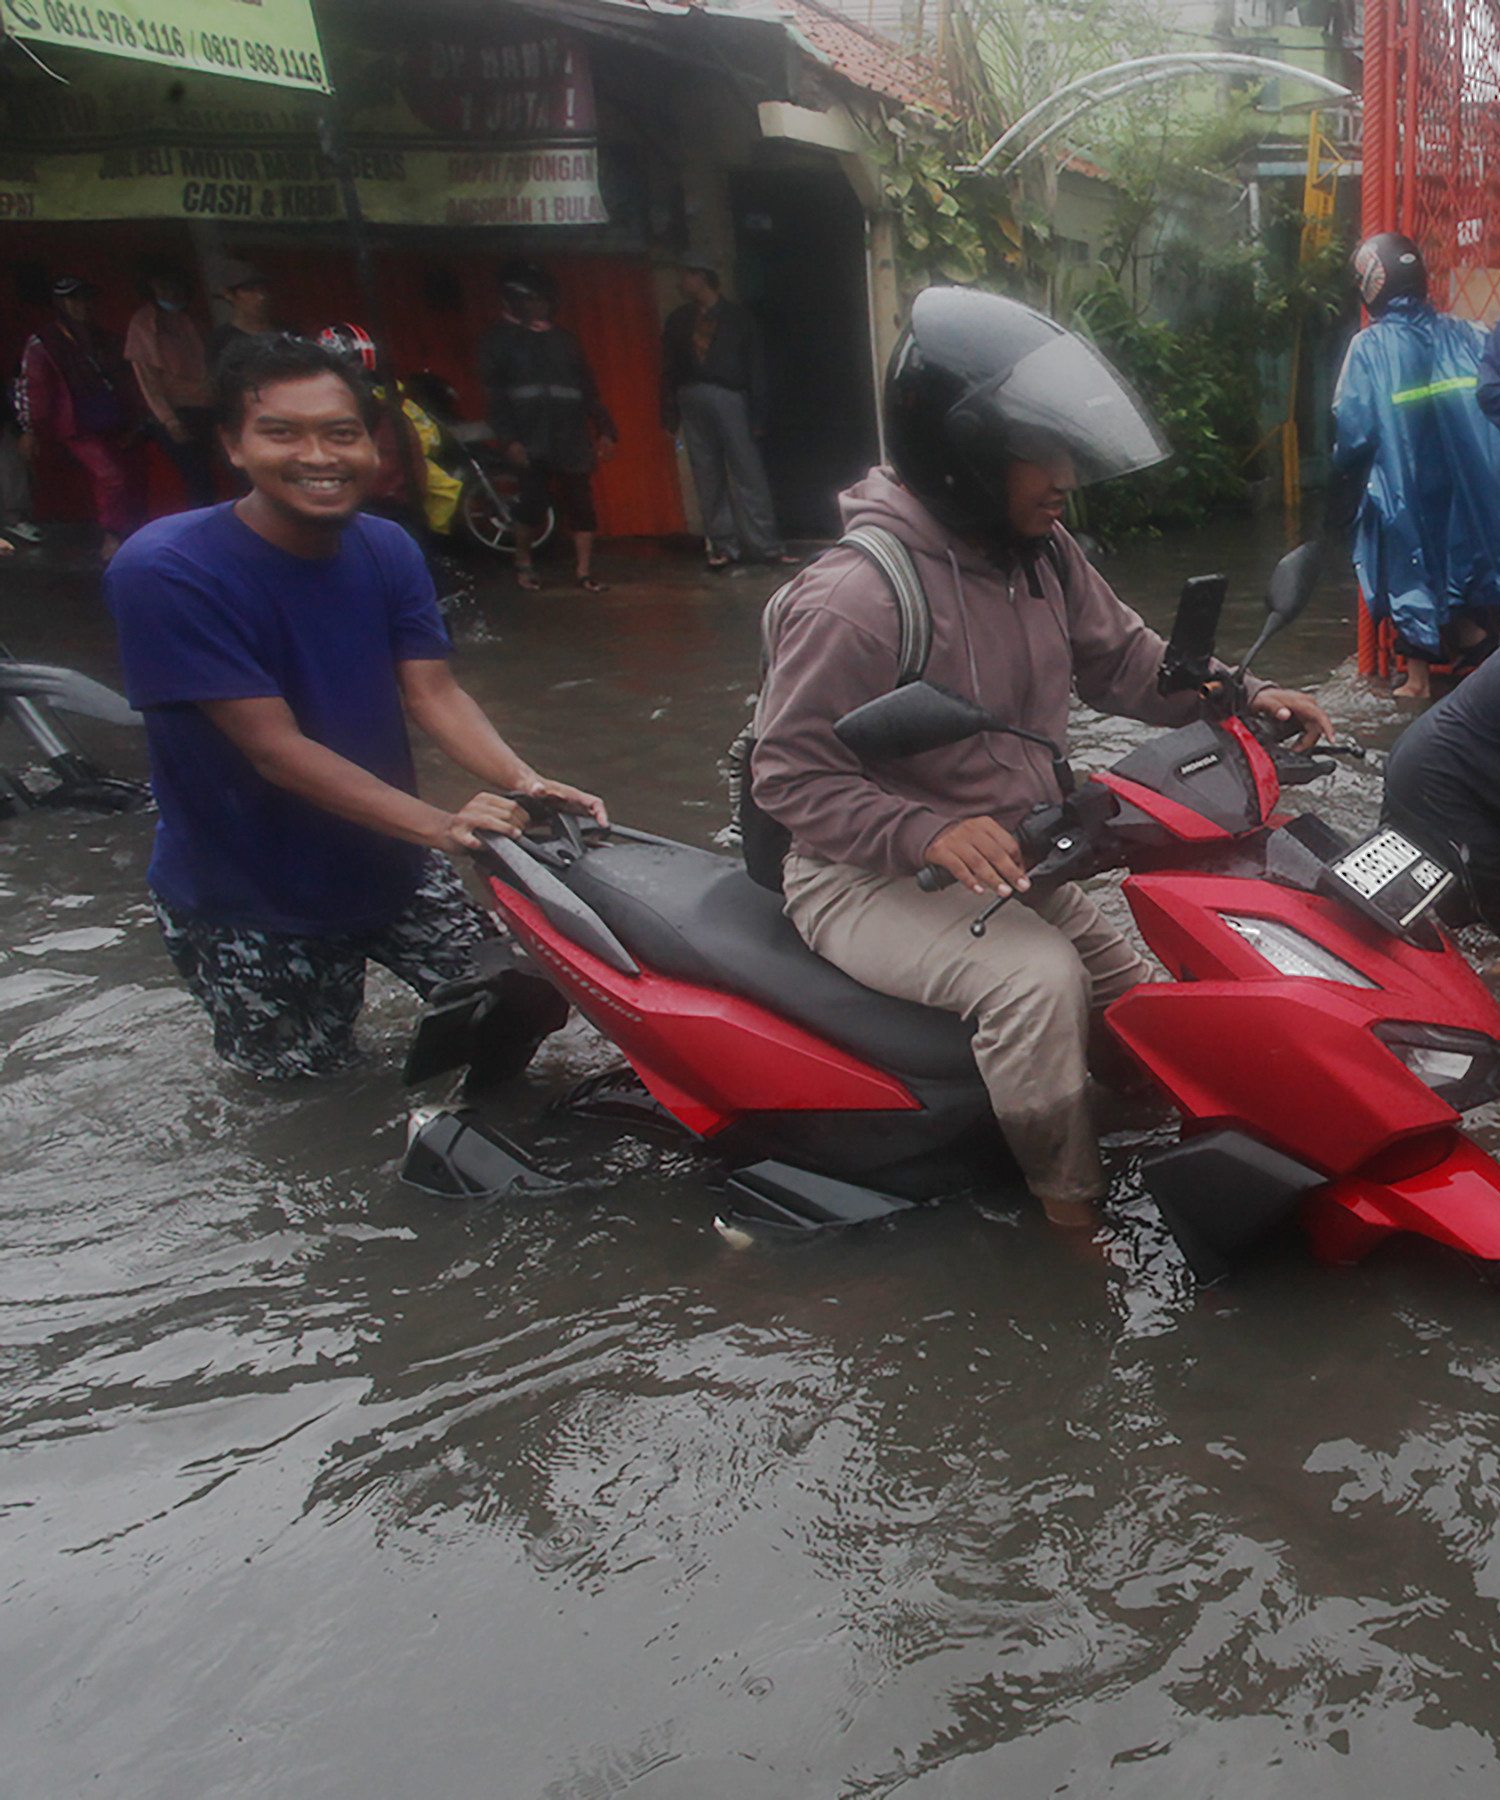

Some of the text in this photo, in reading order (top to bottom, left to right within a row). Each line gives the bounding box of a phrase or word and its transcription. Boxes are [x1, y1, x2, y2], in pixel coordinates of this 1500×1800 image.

[44, 1, 99, 41] 0811
[98, 9, 138, 48] 978
[137, 19, 187, 58] 1116
[201, 33, 243, 69] 0817
[244, 40, 280, 77] 988
[279, 48, 325, 85] 1116
[179, 149, 260, 181] MOTOR
[183, 181, 252, 215] CASH
[261, 188, 276, 217] &
[538, 197, 548, 223] 1
